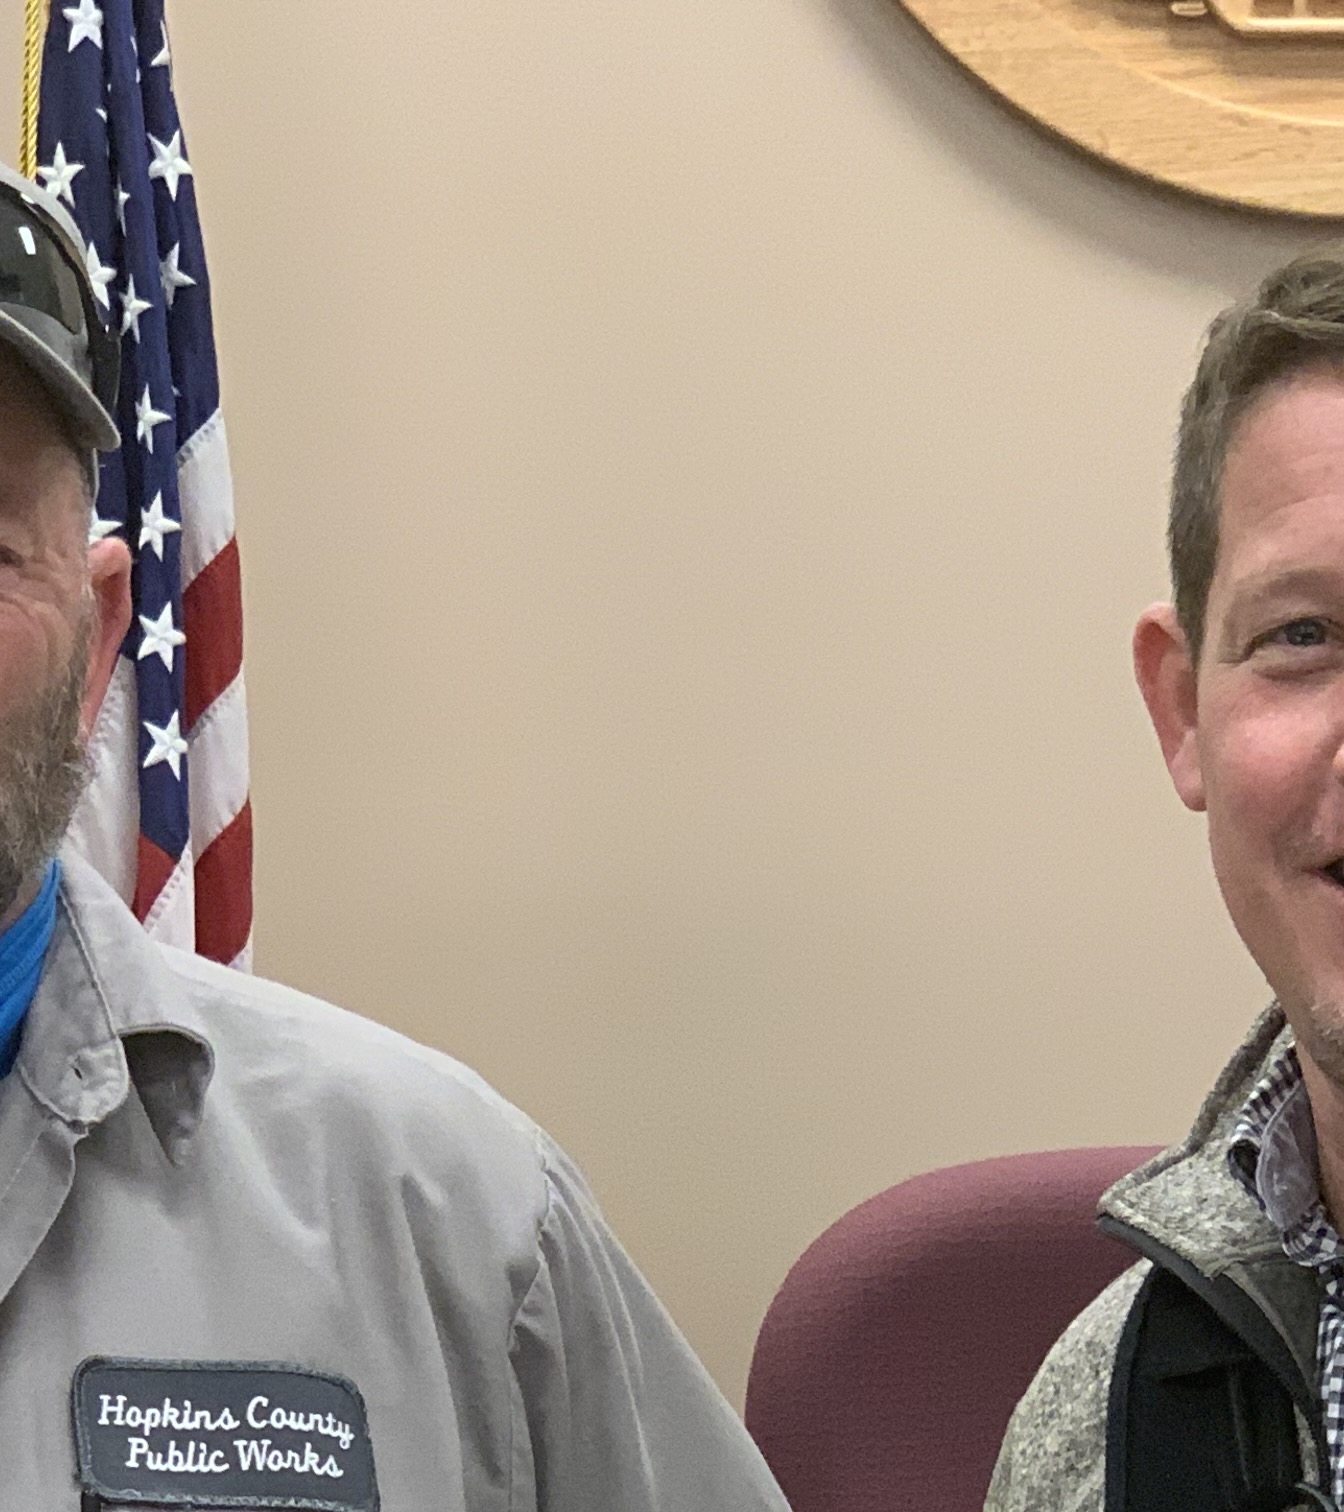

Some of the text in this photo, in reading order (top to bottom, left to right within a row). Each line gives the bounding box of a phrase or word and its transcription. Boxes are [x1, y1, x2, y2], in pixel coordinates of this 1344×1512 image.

[98, 1394, 355, 1449] Hopkins County
[125, 1437, 344, 1478] Public Works
